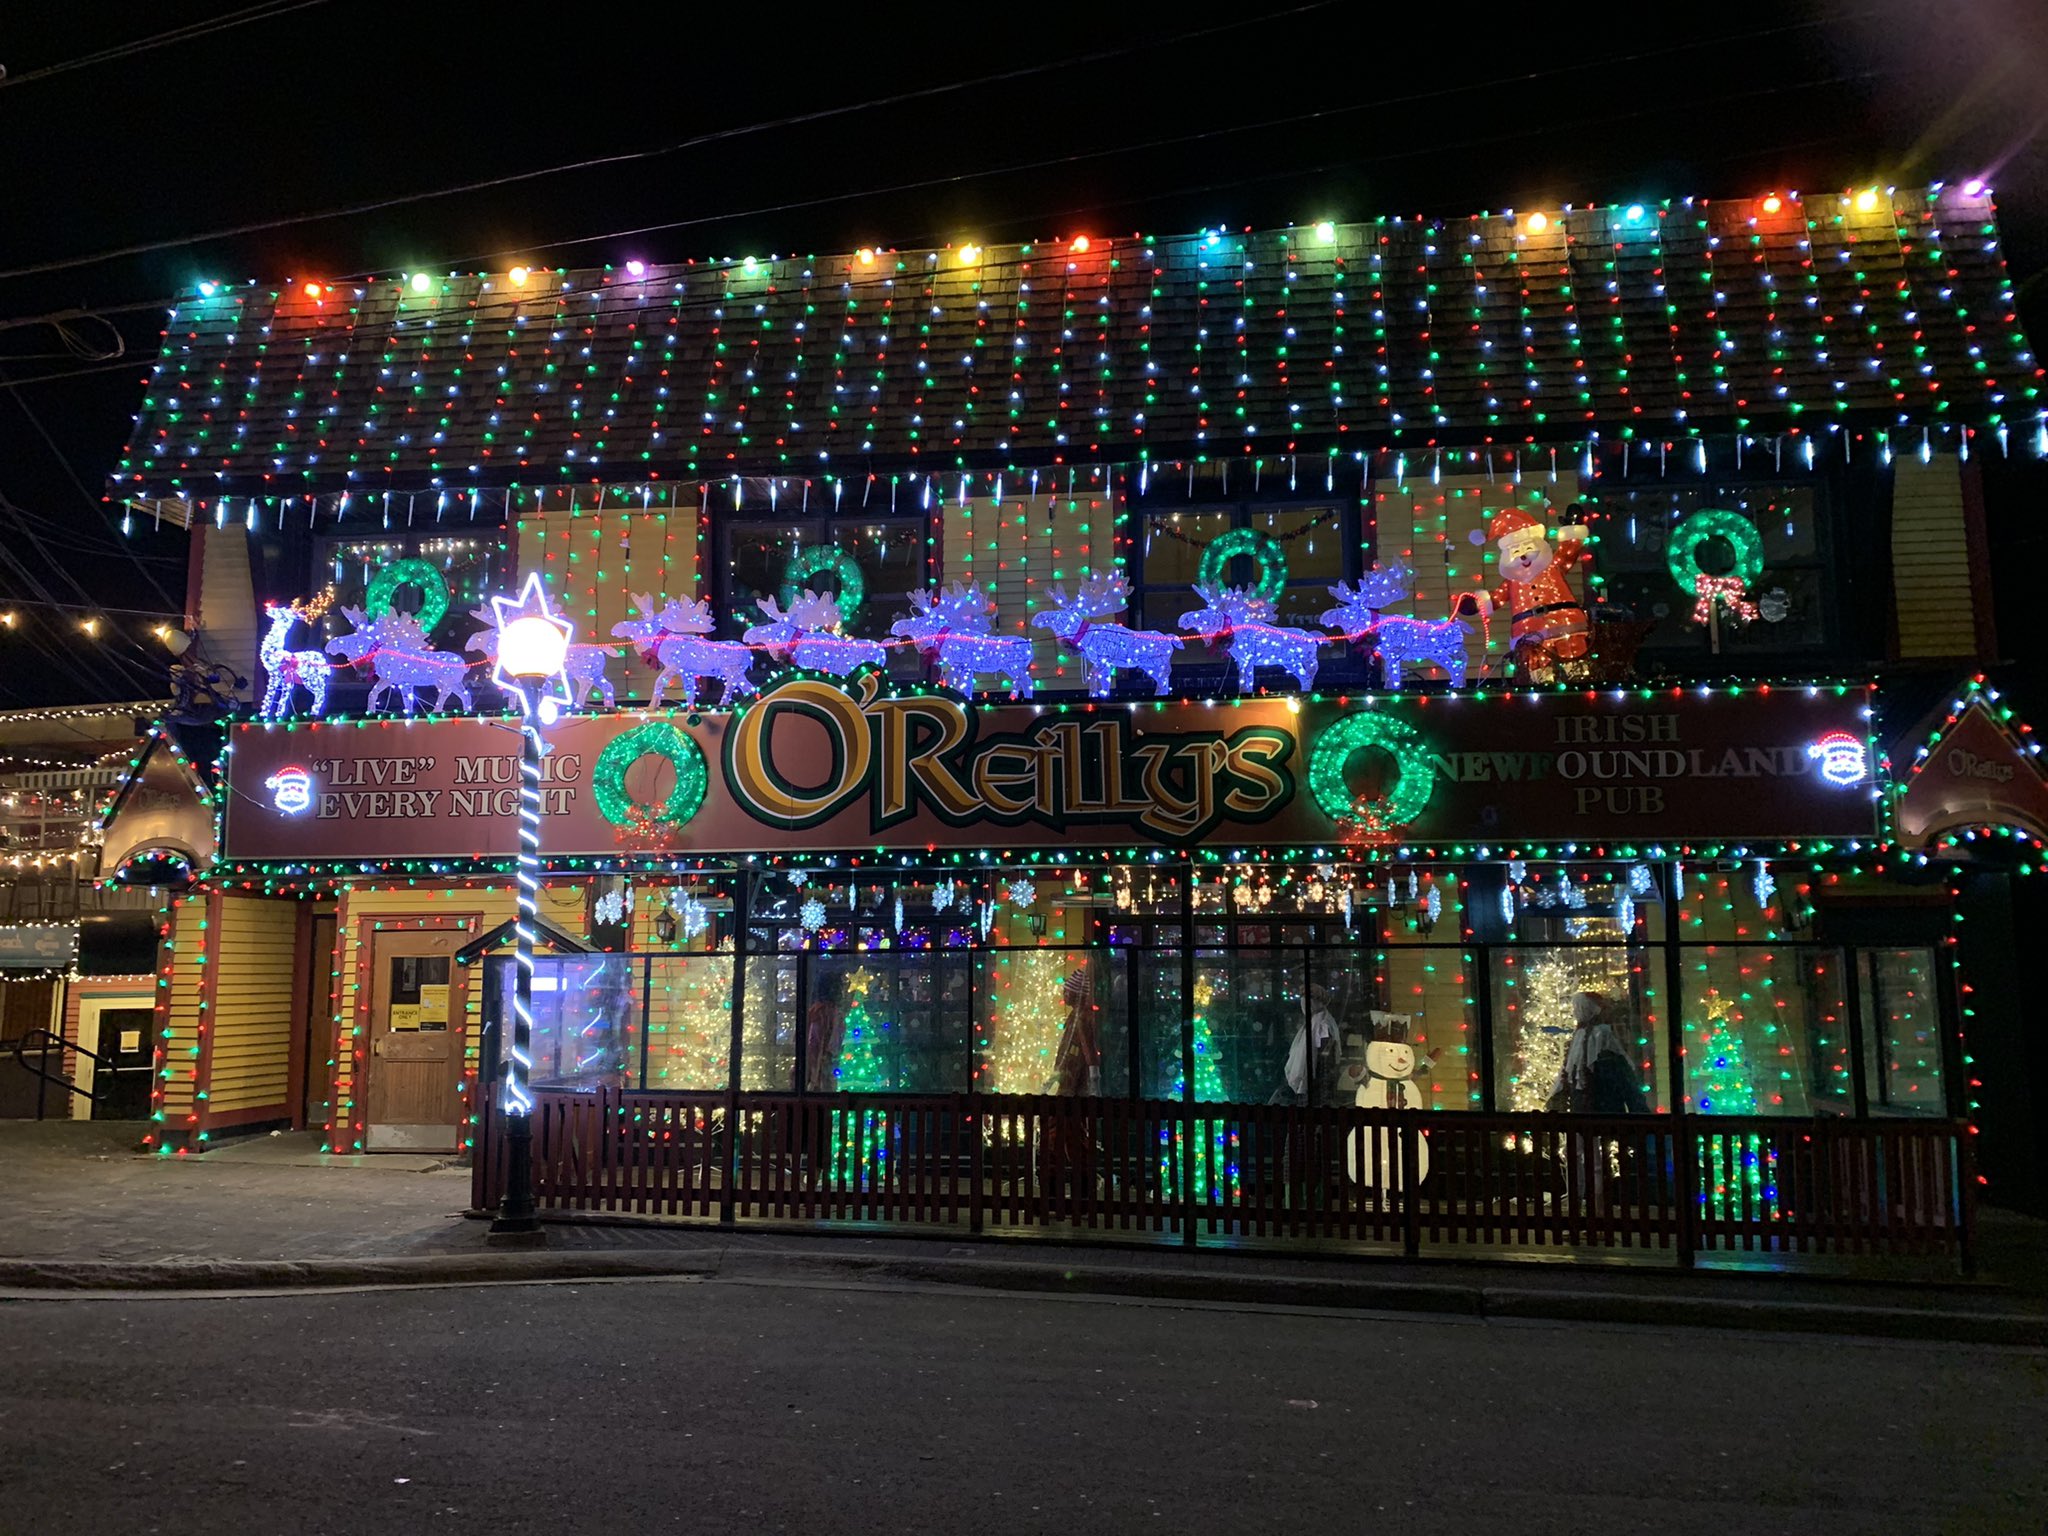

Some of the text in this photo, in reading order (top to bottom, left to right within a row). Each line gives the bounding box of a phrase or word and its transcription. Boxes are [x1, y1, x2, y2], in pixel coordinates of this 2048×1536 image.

[1553, 713, 1681, 745] IRISH
[454, 754, 581, 784] MUIC
[731, 672, 1284, 837] O'Reilly's
[1428, 749, 1811, 781] NEWFOUNDLAND
[316, 790, 441, 819] EVERY
[1574, 785, 1665, 816] PUB
